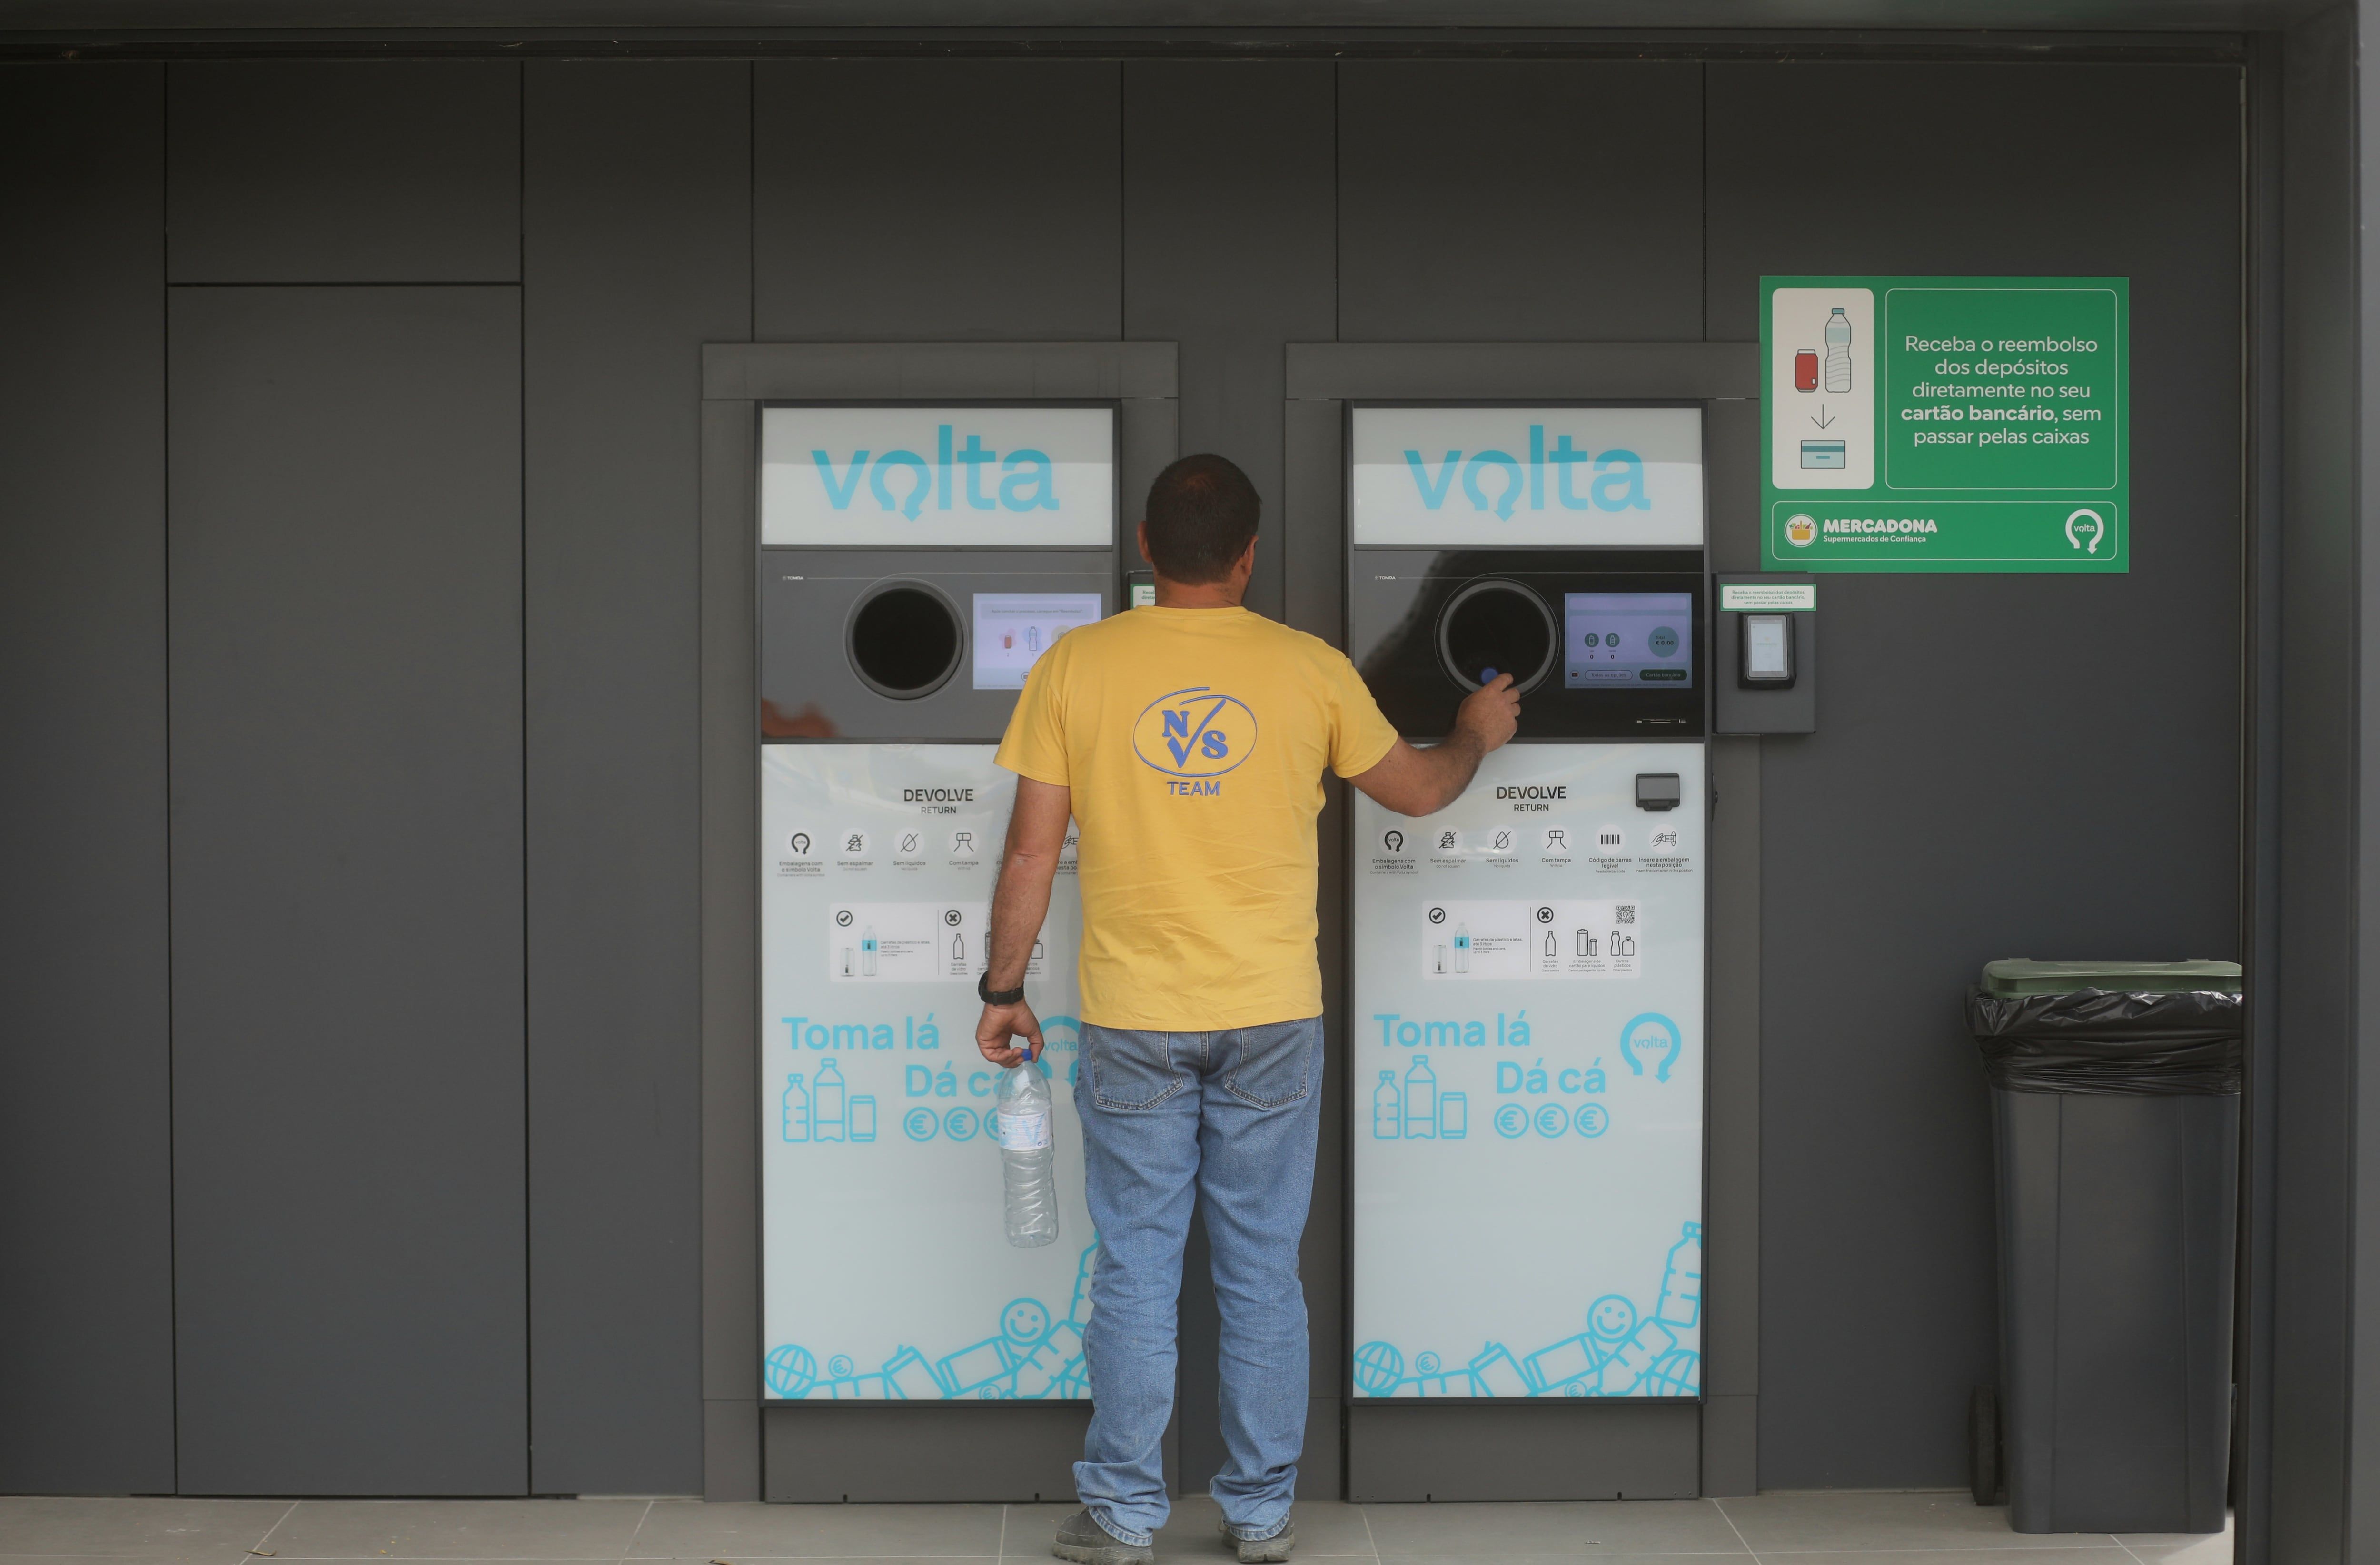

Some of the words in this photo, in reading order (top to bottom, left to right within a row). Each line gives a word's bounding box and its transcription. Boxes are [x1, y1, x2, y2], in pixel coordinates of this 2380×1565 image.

[1905, 335, 1975, 352] Receba
[1981, 339, 1993, 352] o
[1999, 335, 2098, 352] reembolso
[1935, 357, 1969, 375] dos
[1974, 357, 2068, 378] depósitos
[1912, 382, 2024, 398] diretamente
[2031, 386, 2053, 398] no
[2059, 386, 2090, 398] seu
[1901, 405, 1964, 421] cartão
[1970, 405, 2058, 424] bancário,
[2063, 408, 2101, 421] sem
[1914, 431, 1973, 447] passar
[1979, 428, 2027, 447] pelas
[2032, 428, 2089, 444] caixas
[811, 425, 1059, 522] volta
[1403, 425, 1651, 522] volta
[1823, 519, 1938, 534] MERCADONA
[2073, 524, 2095, 534] volta
[1823, 535, 1878, 544] Supermercados
[1891, 535, 1926, 544] Confiança
[904, 789, 973, 802] DEVOLVE
[1167, 781, 1220, 796] TEAM
[1497, 786, 1566, 799] DEVOLVE
[782, 1017, 894, 1050] Toma
[906, 1013, 939, 1050] lá
[1374, 1014, 1485, 1047] Toma
[1497, 1010, 1530, 1047] lá
[1044, 1039, 1078, 1052] volta
[1633, 1035, 1668, 1049] volta
[906, 1061, 957, 1097] Dá
[1497, 1057, 1548, 1094] Dá
[1558, 1057, 1606, 1094] cá
